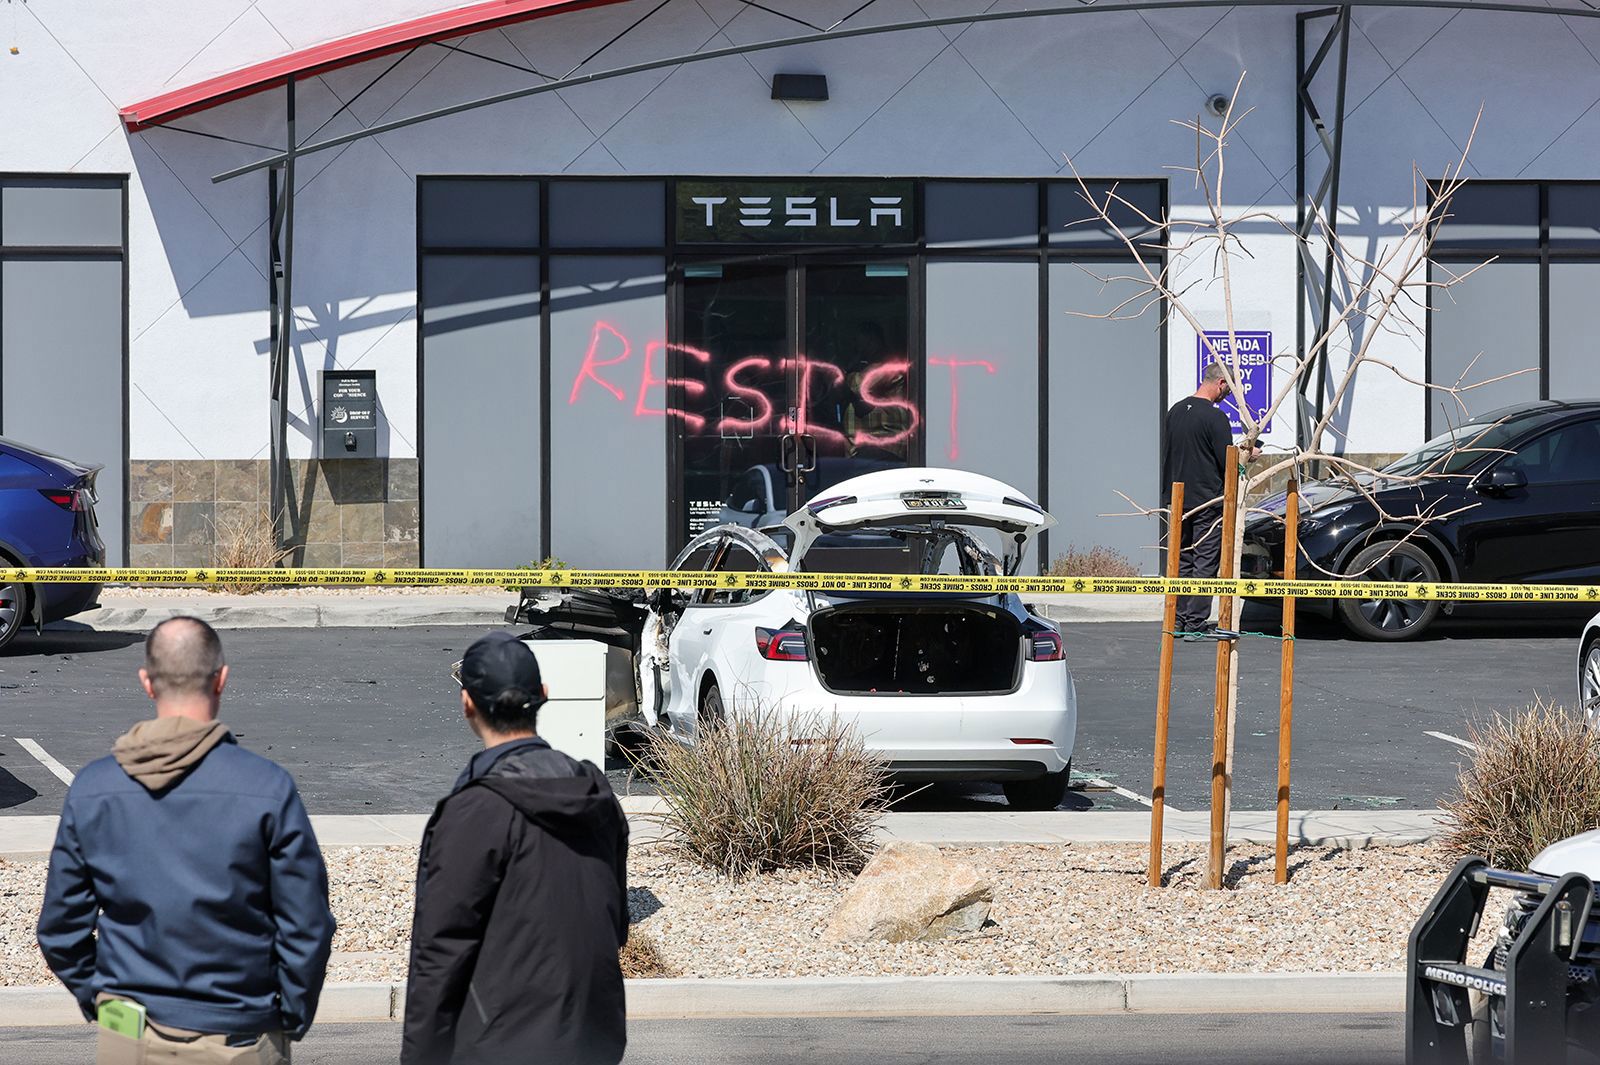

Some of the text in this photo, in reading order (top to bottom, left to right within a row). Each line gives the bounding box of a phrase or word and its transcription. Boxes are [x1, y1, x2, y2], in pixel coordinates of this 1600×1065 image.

[692, 197, 902, 226] TESLA
[1212, 339, 1260, 351] NEADA
[567, 320, 996, 461] RESIST
[1425, 966, 1506, 996] METRO POLICE
